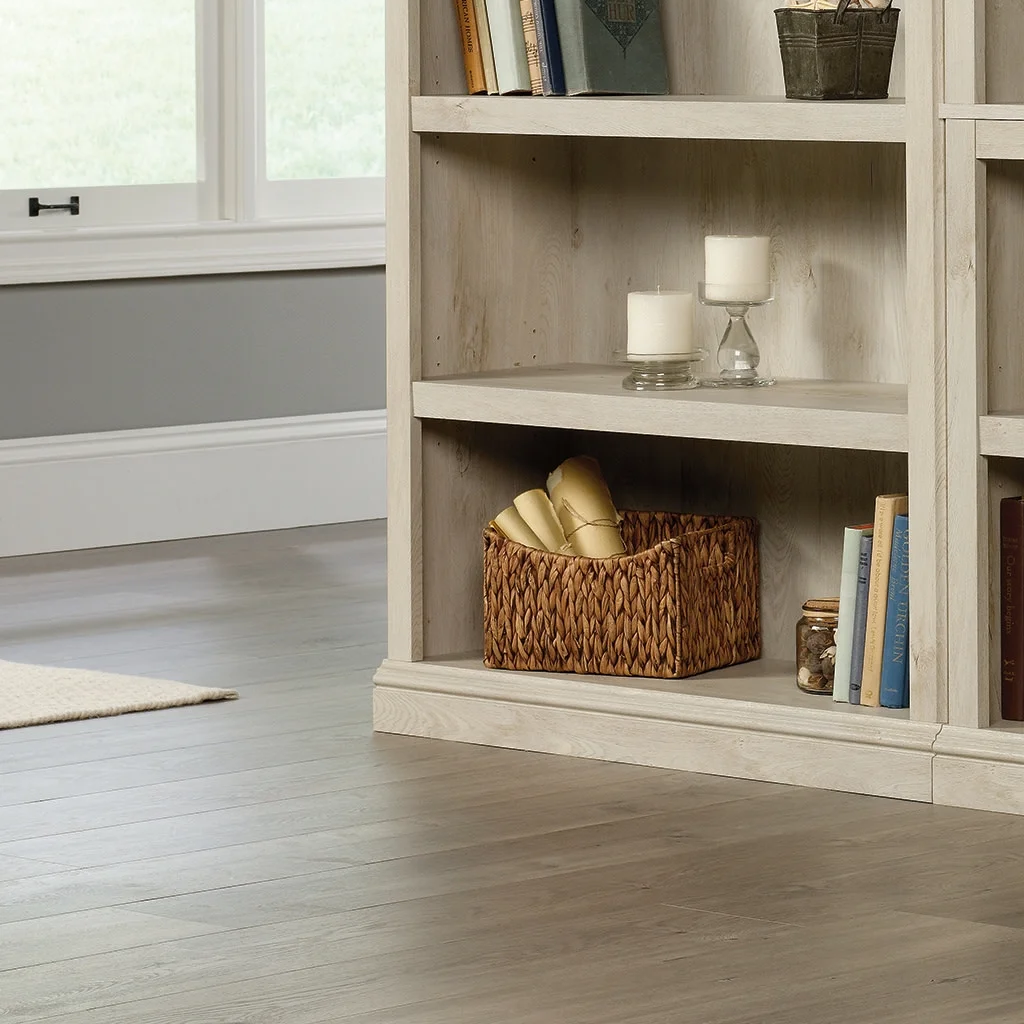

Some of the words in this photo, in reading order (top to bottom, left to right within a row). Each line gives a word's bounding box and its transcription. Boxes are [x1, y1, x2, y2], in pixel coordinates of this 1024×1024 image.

[608, 4, 635, 21] HUR
[465, 25, 474, 52] HOMES
[898, 528, 909, 595] GOLDEN
[1005, 554, 1015, 576] Our
[893, 602, 908, 664] URCHIN
